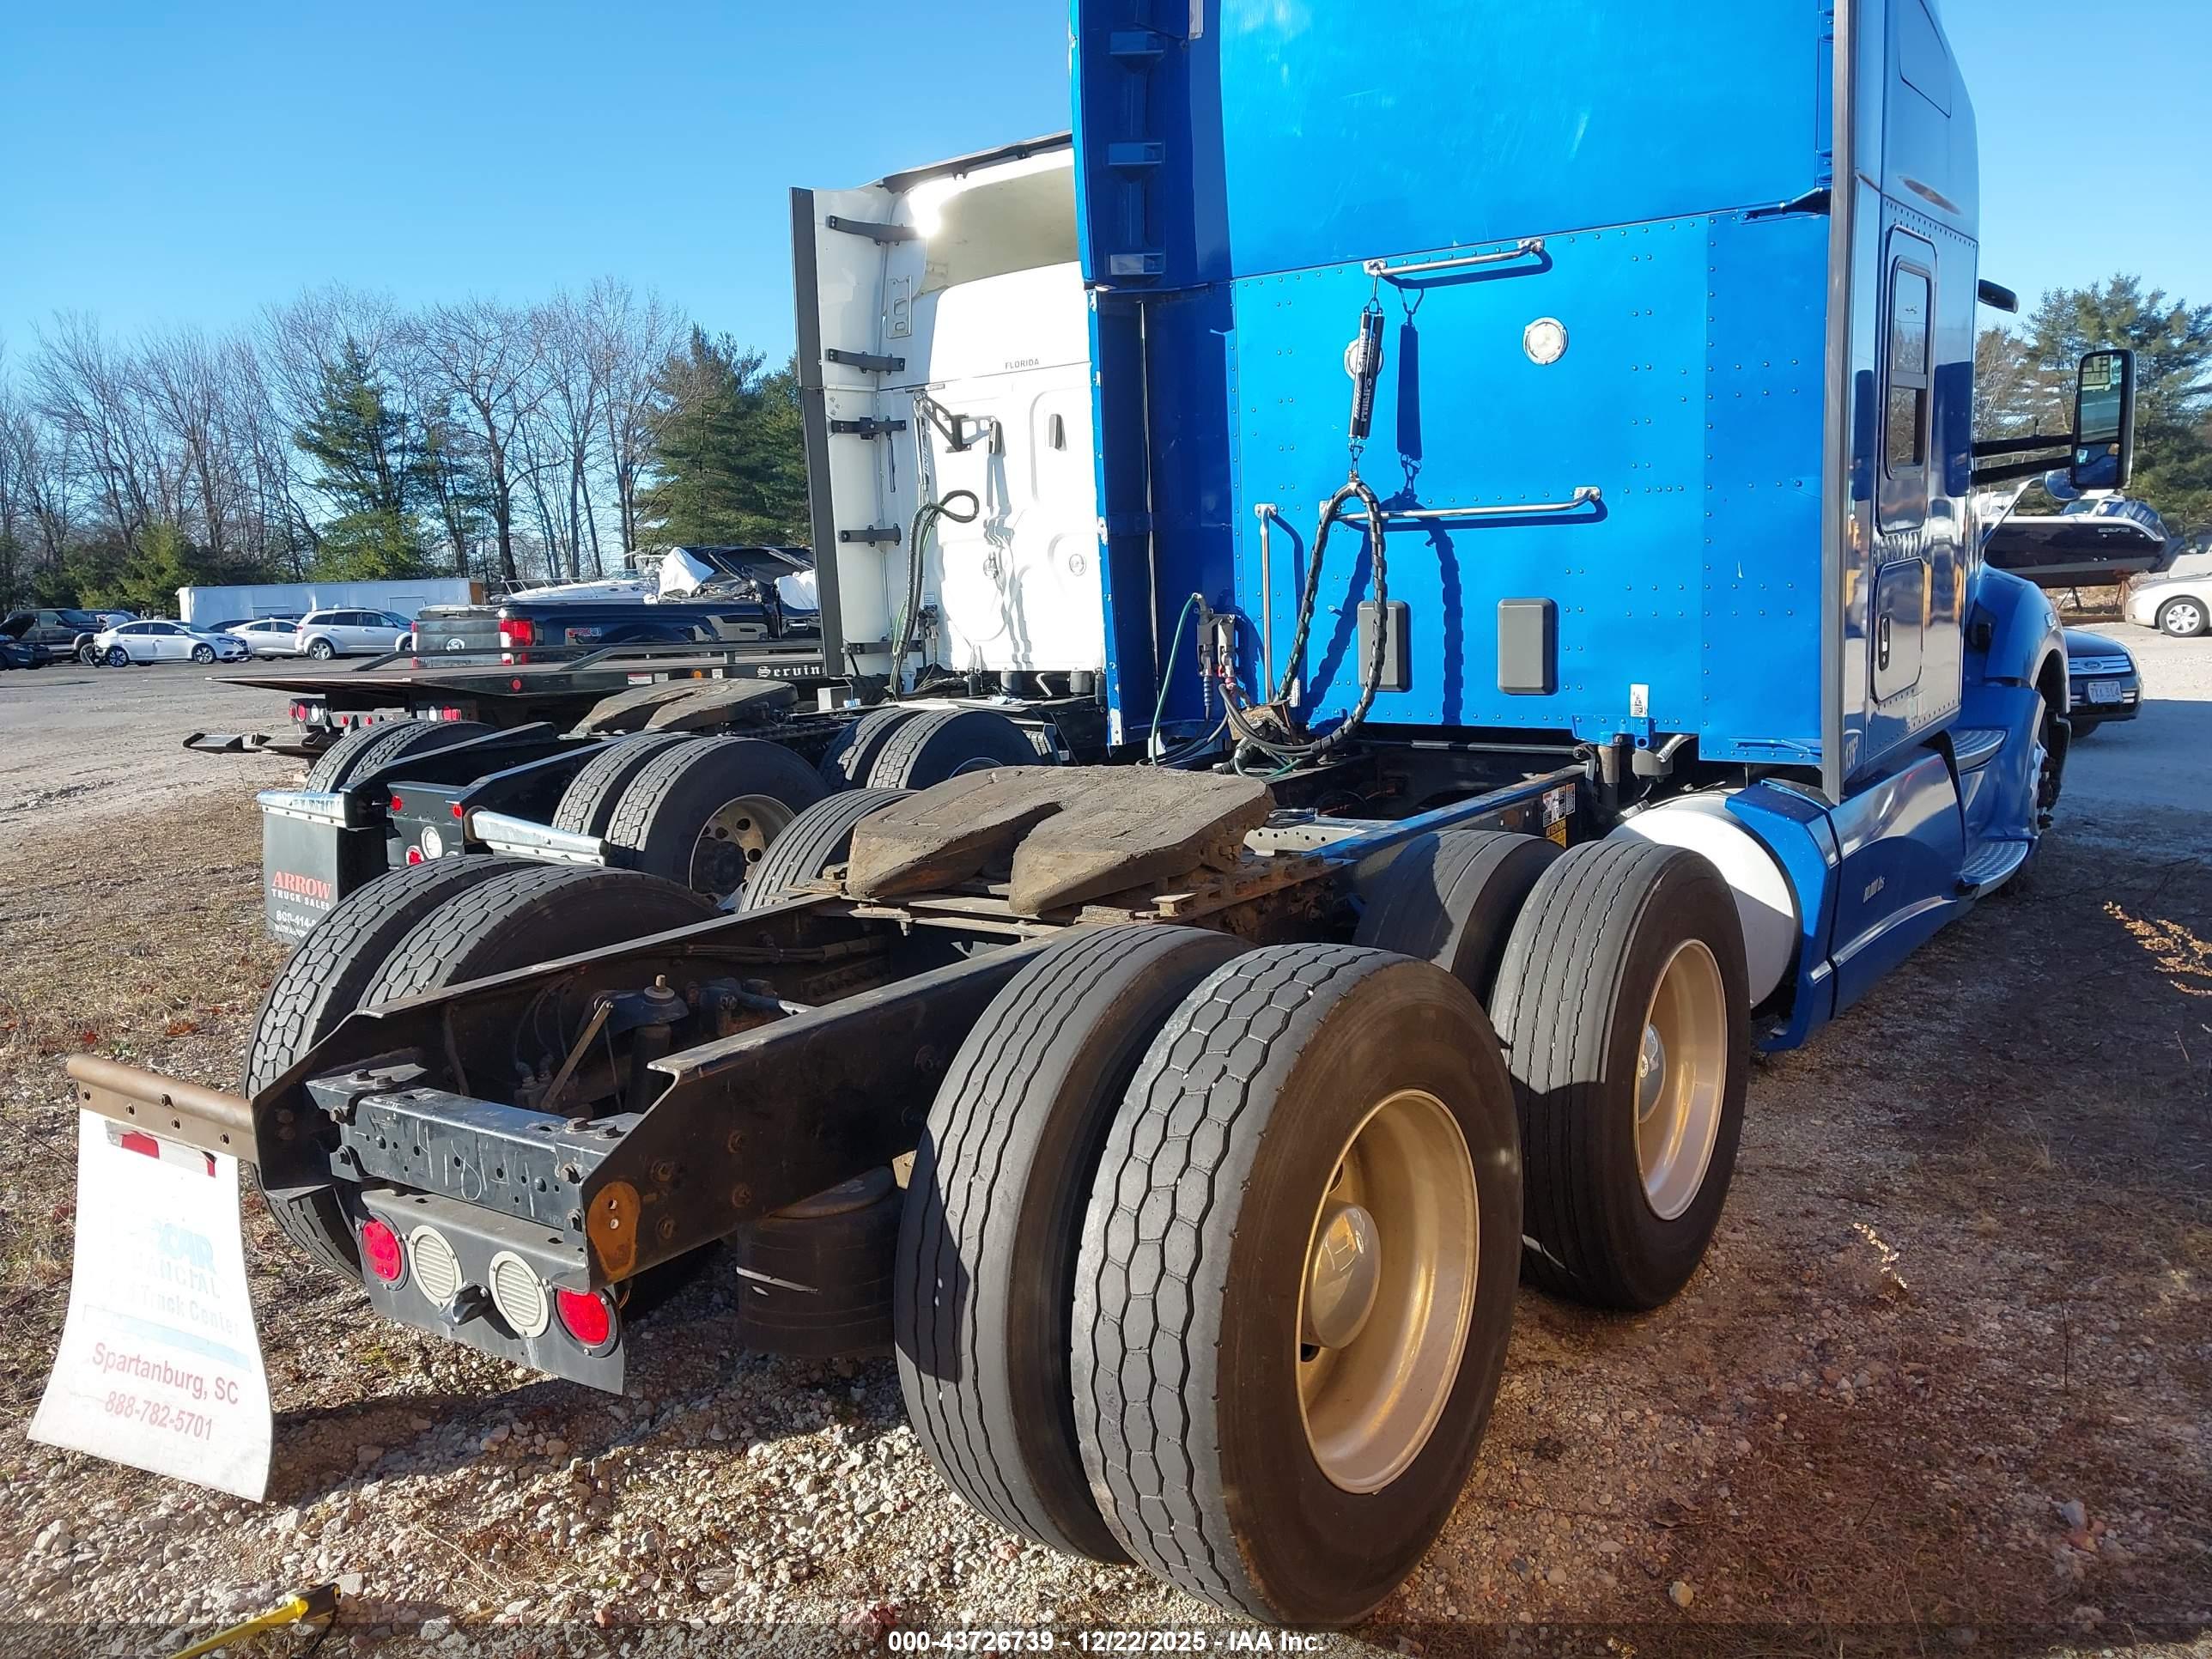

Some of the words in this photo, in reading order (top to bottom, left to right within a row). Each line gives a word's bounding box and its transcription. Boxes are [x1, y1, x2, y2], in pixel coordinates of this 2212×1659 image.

[1005, 358, 1039, 370] FLORIDA
[271, 871, 331, 900] ARROW
[271, 888, 301, 903] TRUCK
[304, 896, 330, 912] SALES
[92, 1342, 208, 1400] Spartanburg,
[215, 1376, 239, 1405] SC
[105, 1390, 213, 1442] 888-782-5701
